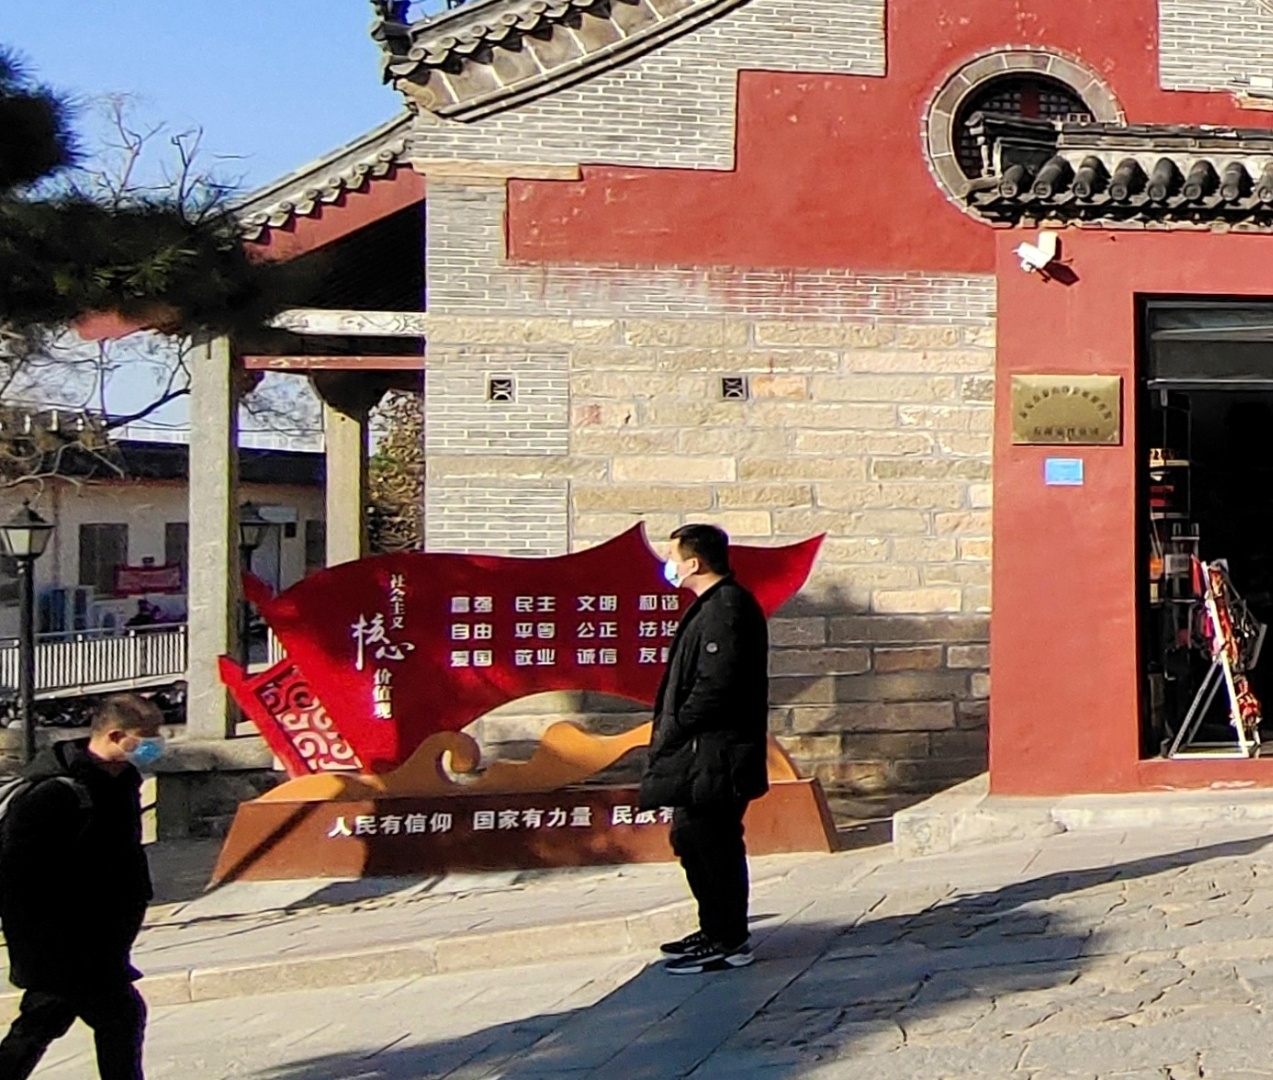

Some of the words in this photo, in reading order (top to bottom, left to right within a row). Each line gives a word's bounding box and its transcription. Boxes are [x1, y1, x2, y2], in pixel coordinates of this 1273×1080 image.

[390, 574, 406, 629] 社会主义
[515, 596, 556, 613] 民主
[577, 595, 618, 612] 文明
[639, 595, 680, 611] 和谐
[351, 613, 415, 670] 核心
[451, 623, 493, 640] 自由
[577, 622, 618, 638] 公正
[639, 621, 679, 637] 法治
[451, 650, 493, 667] 爱国
[515, 648, 556, 666] 敬业
[577, 648, 618, 665] 诚信
[328, 813, 453, 838] 人民有信仰
[473, 806, 593, 832] 国家有力量
